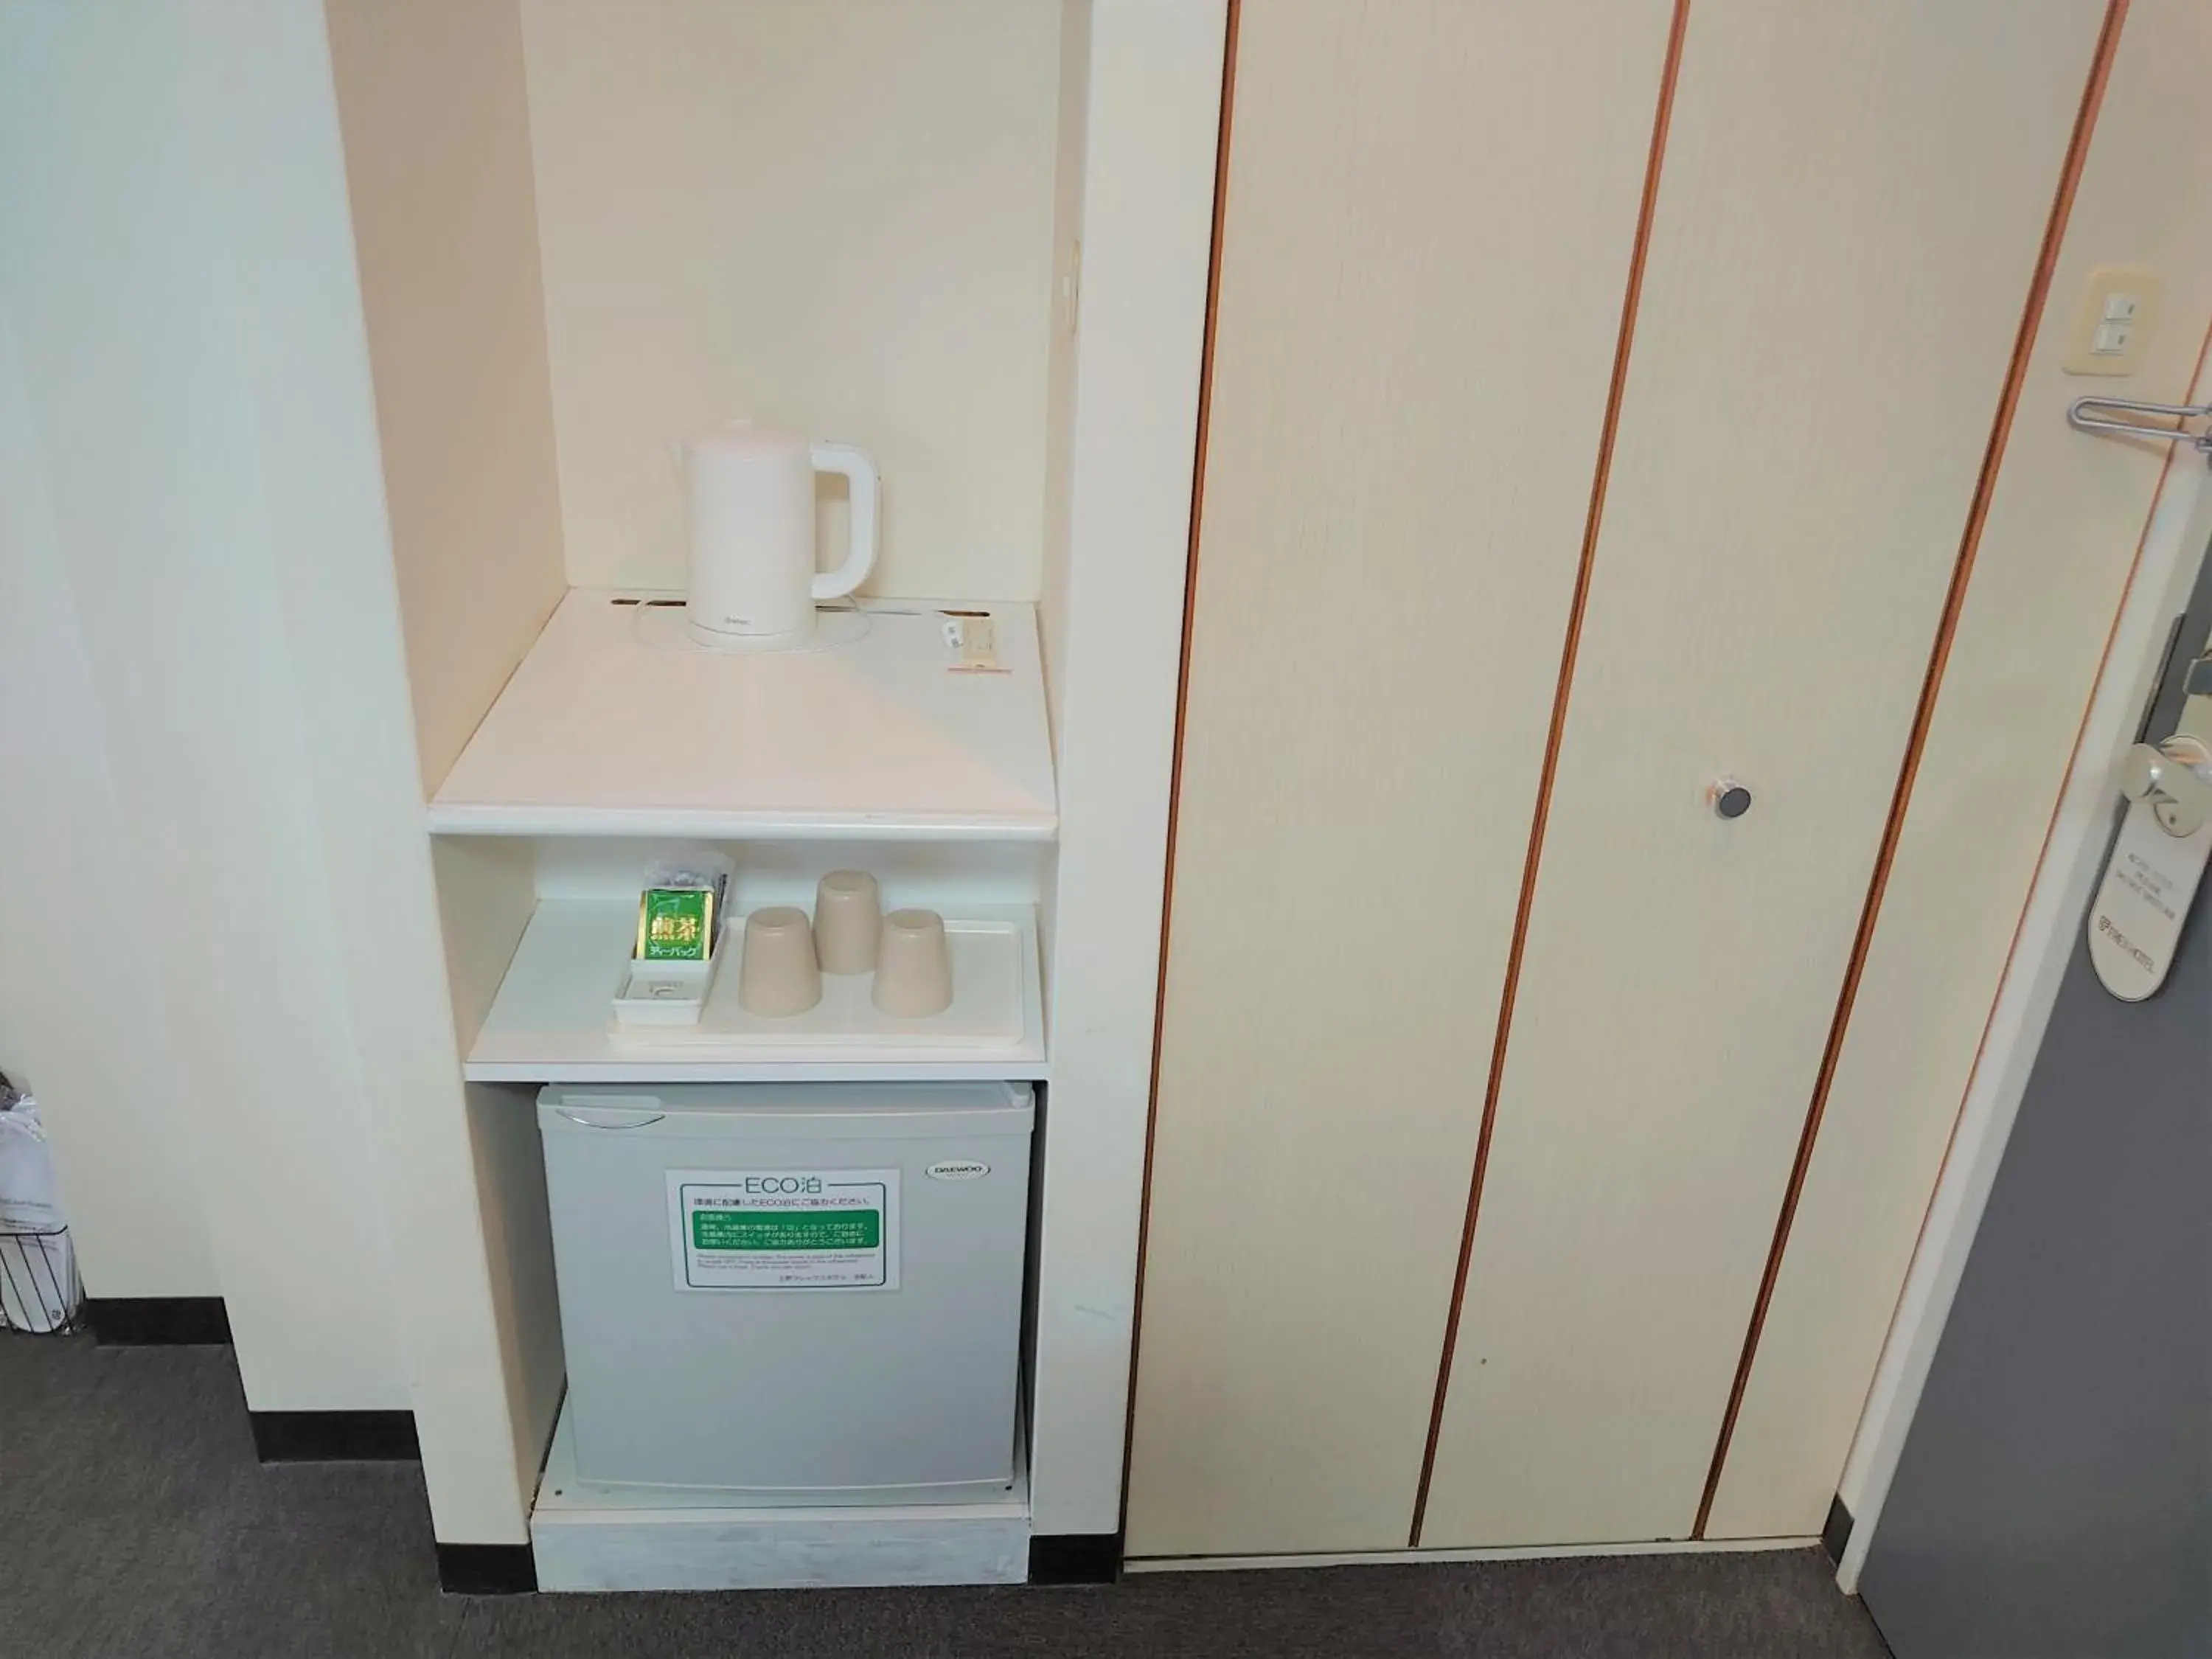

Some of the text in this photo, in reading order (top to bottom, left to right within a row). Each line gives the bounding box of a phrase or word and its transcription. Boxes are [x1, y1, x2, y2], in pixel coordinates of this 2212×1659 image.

[649, 945, 697, 956] ティーバッグ
[745, 1177, 822, 1194] ECO泊
